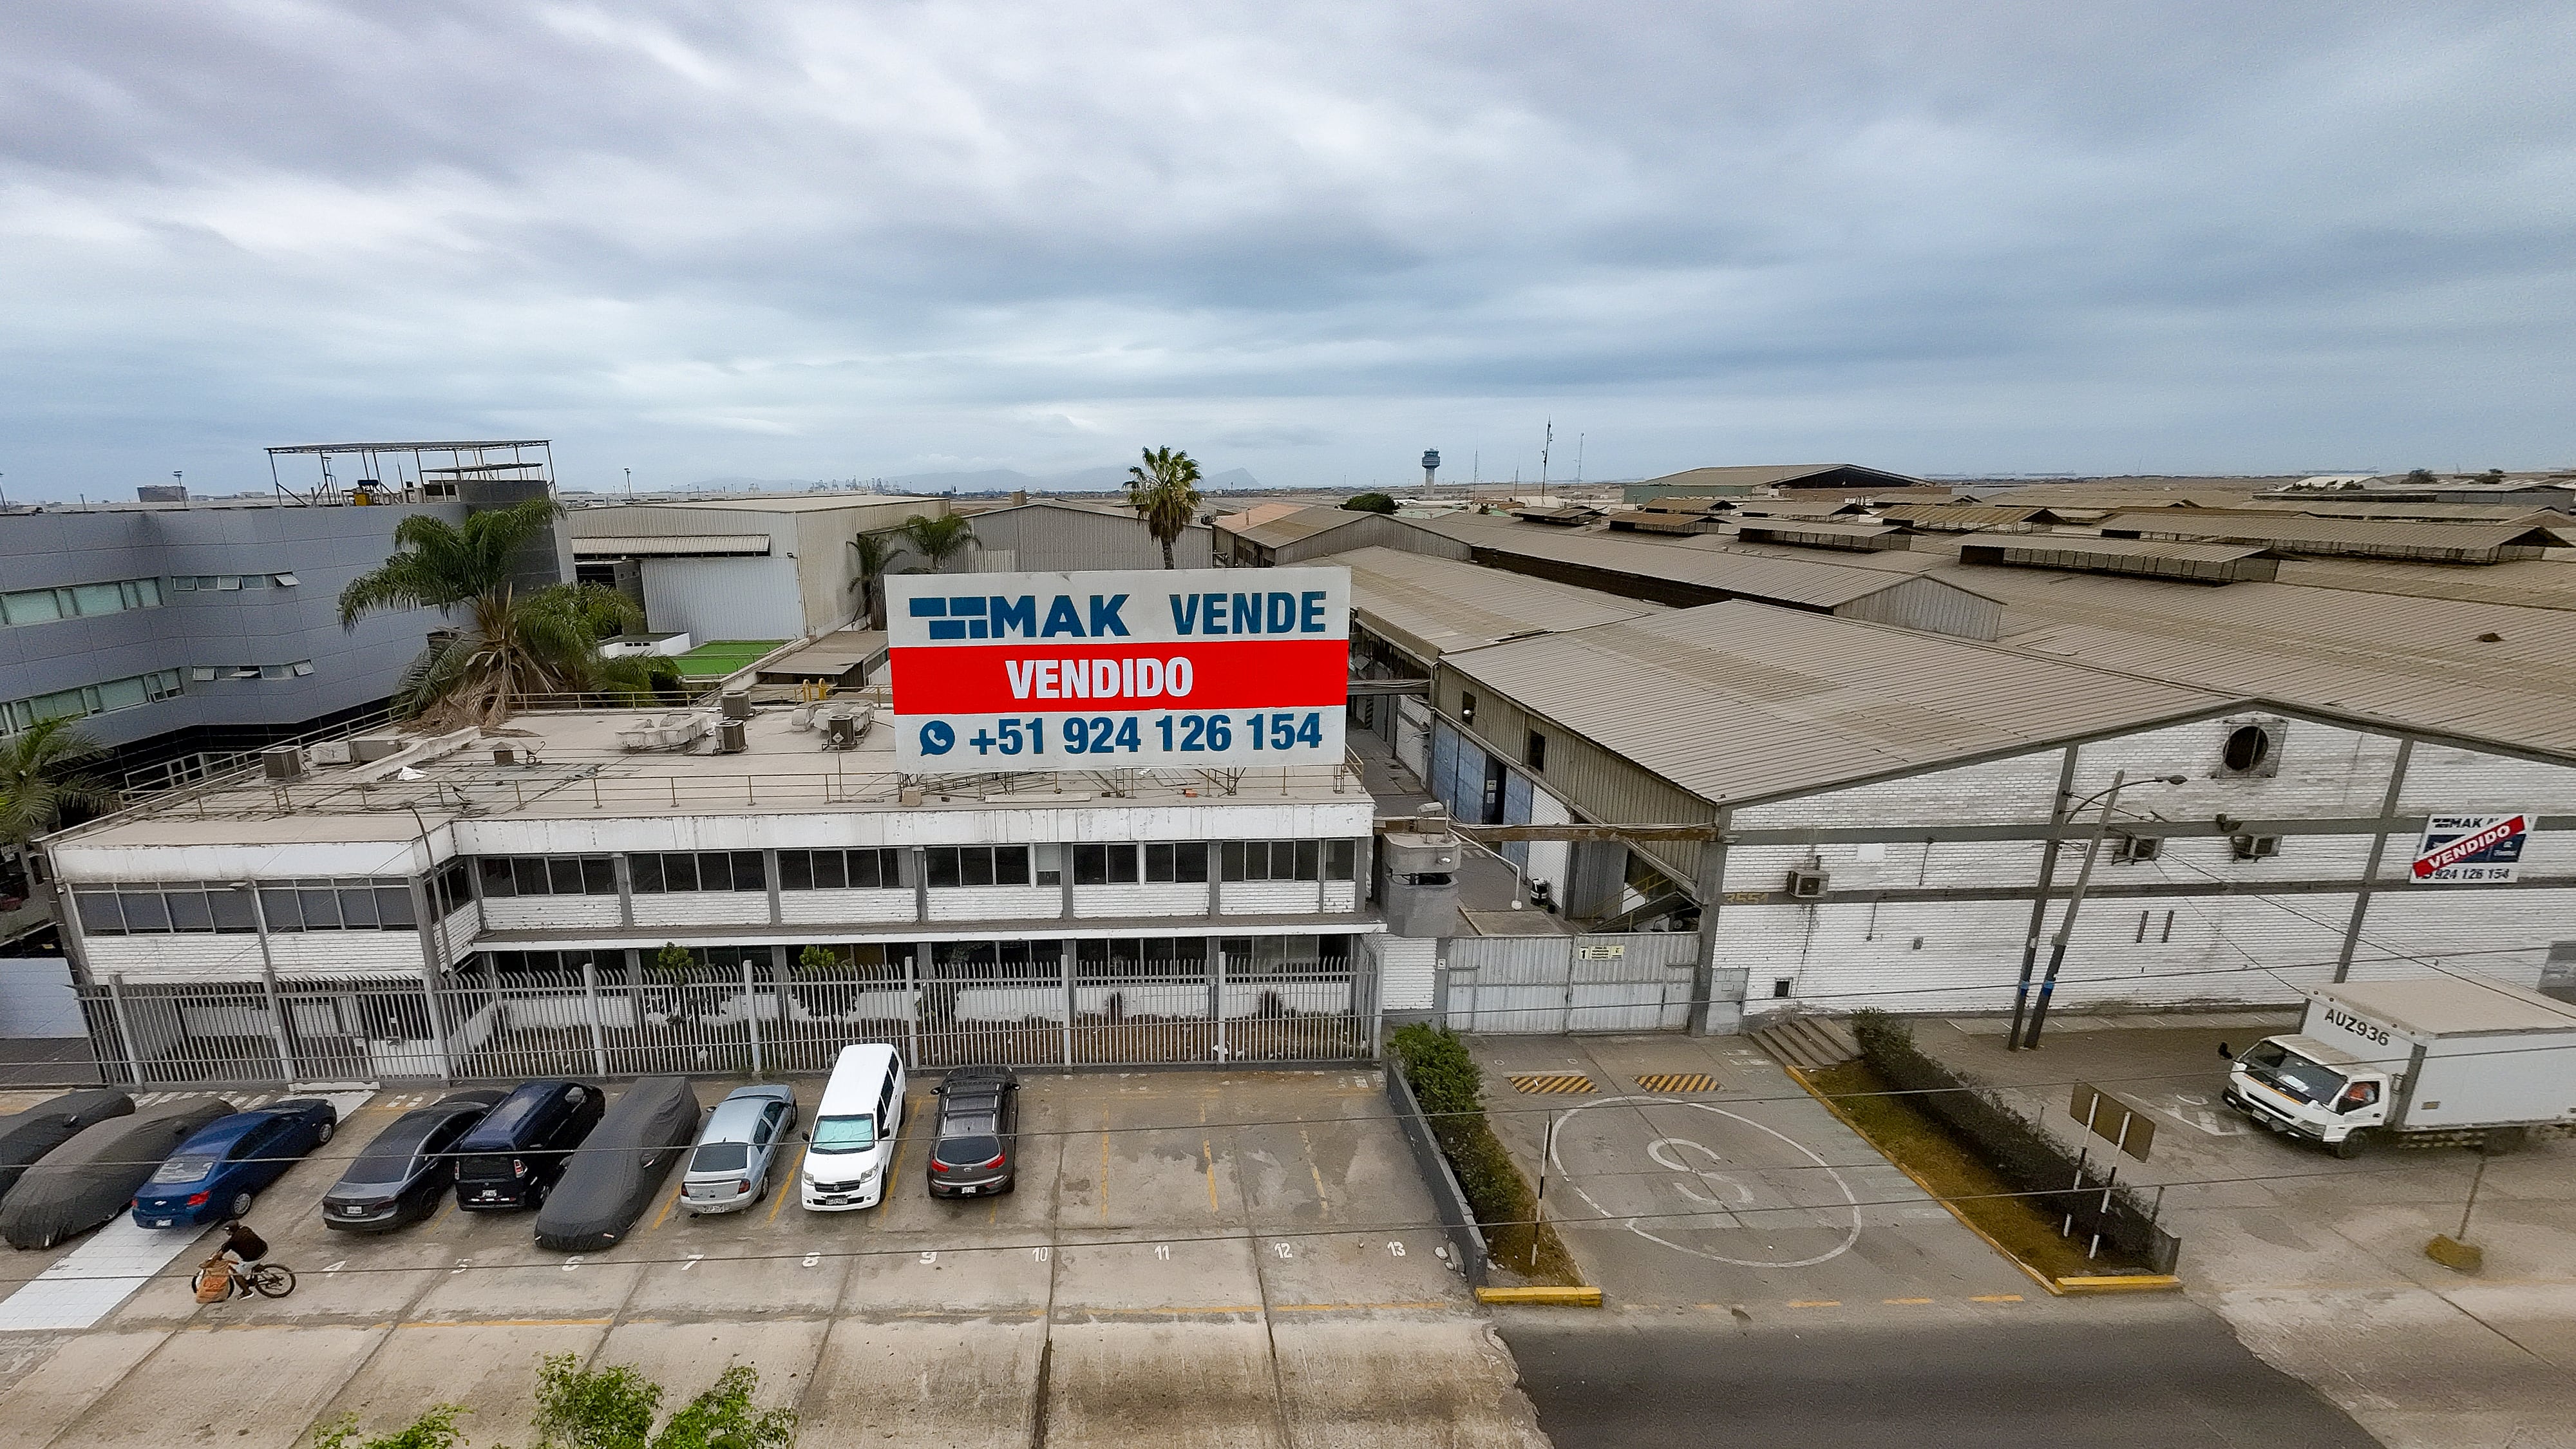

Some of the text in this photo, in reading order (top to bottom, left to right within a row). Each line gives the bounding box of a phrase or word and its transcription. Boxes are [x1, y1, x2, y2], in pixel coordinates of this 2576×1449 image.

[989, 591, 1327, 639] MAK VENDE
[1005, 656, 1193, 700] VENDIDO
[969, 712, 1323, 756] +51 924 126 154
[2449, 817, 2483, 829] MAK
[2427, 824, 2511, 869] VENDIDO
[2324, 1009, 2391, 1046] AUZ936
[919, 1249, 938, 1265] 9
[1032, 1246, 1048, 1263] 10
[1154, 1244, 1170, 1261] 11
[1274, 1242, 1293, 1259] 12
[1387, 1240, 1406, 1257] 13
[561, 1255, 585, 1272] 6
[680, 1254, 705, 1271] 7
[802, 1251, 822, 1267] 8
